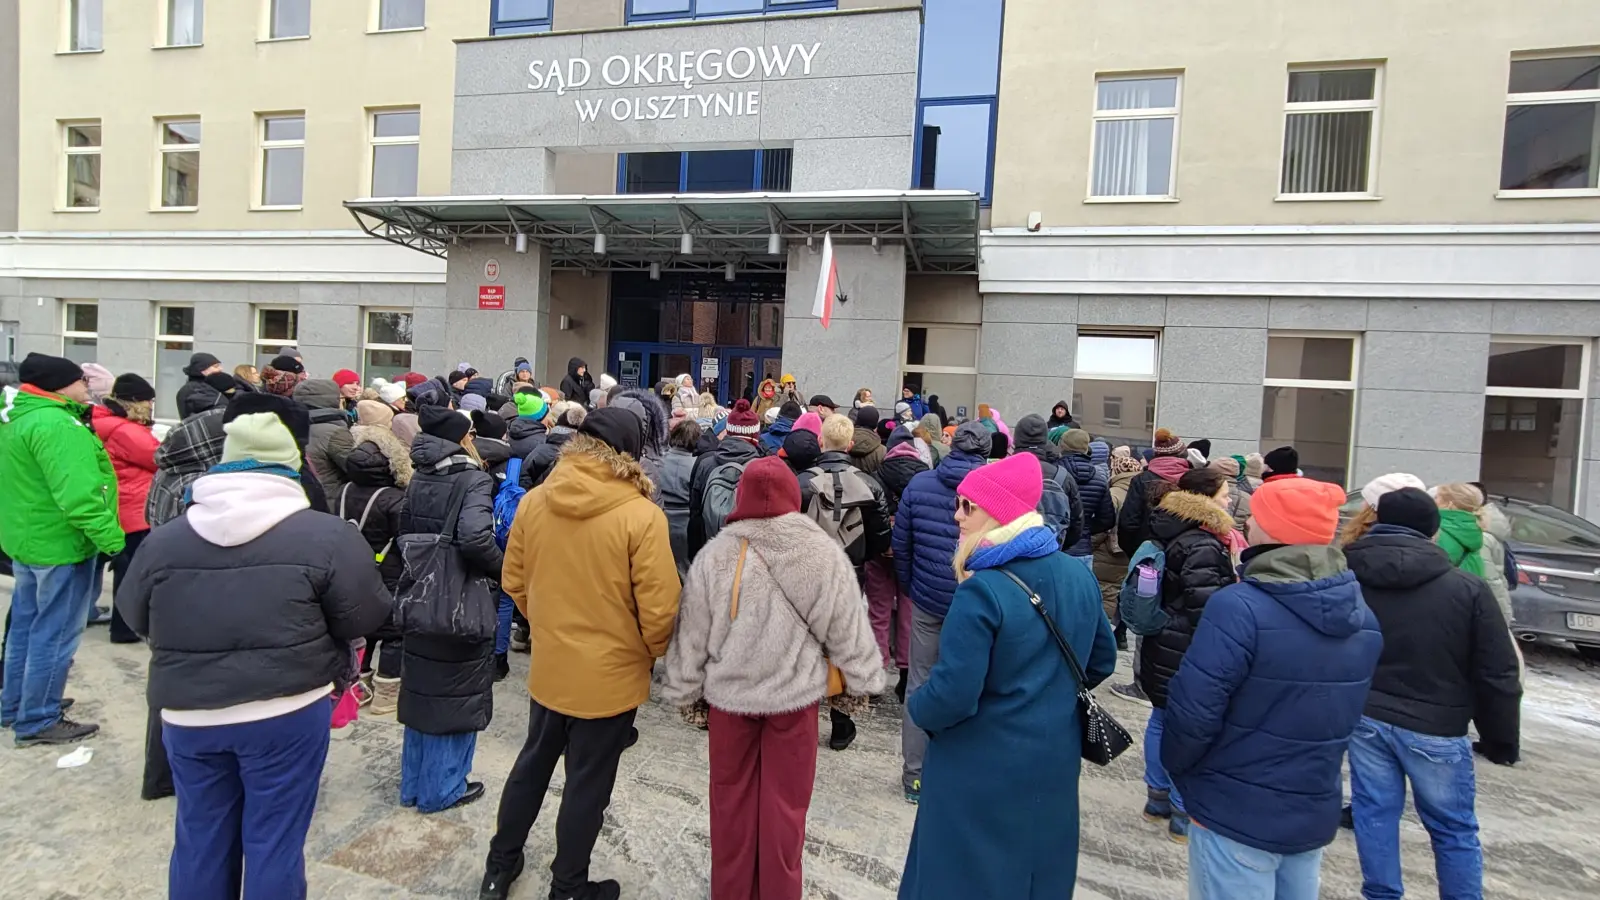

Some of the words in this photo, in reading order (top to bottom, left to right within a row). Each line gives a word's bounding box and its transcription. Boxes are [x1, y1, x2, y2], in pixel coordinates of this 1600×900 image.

[527, 57, 591, 95] SĄD
[602, 42, 821, 89] OKRĘGOWY
[575, 99, 603, 122] W
[610, 91, 760, 121] OLSZTYNIE
